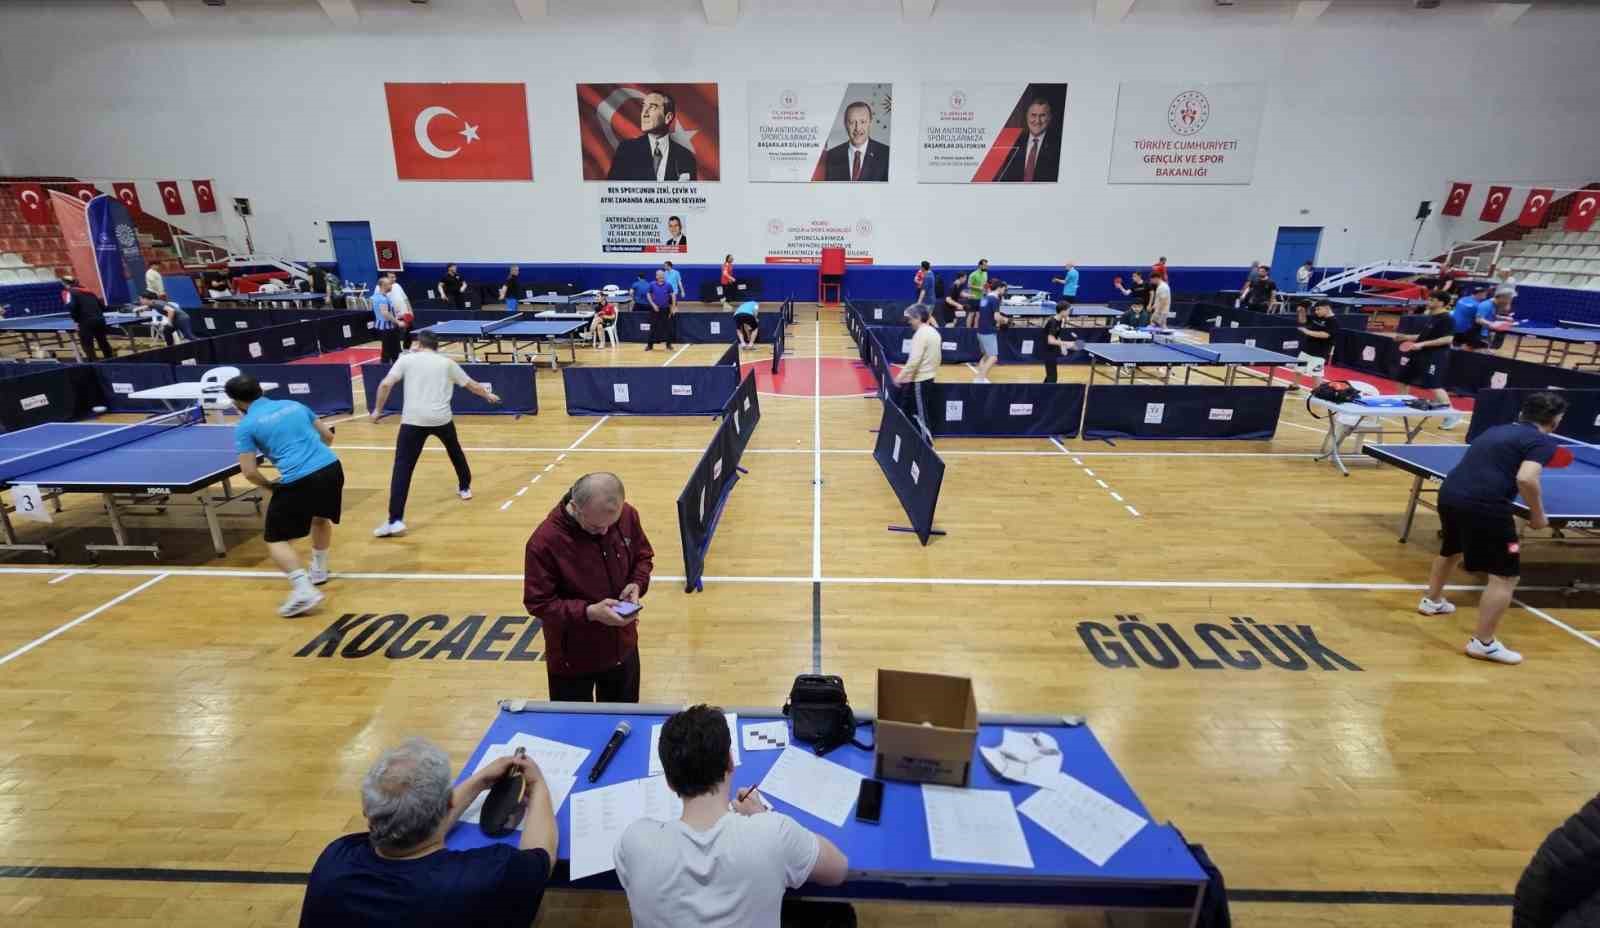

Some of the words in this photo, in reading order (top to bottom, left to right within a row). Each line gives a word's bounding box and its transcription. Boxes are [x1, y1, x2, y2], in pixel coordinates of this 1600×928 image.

[1135, 139, 1173, 150] TÜRKİYE
[1174, 139, 1238, 150] CUMHURİYETİ
[1143, 153, 1183, 165] GENÇLİK
[1185, 154, 1197, 163] VE
[1198, 154, 1224, 164] SPOR
[1156, 167, 1208, 177] BAKANLIĞI
[147, 487, 171, 495] JOOLA
[23, 495, 35, 512] 3
[1566, 520, 1595, 529] JOOLA
[293, 613, 545, 661] KOCAEL
[1076, 614, 1366, 672] GÖLCÜK
